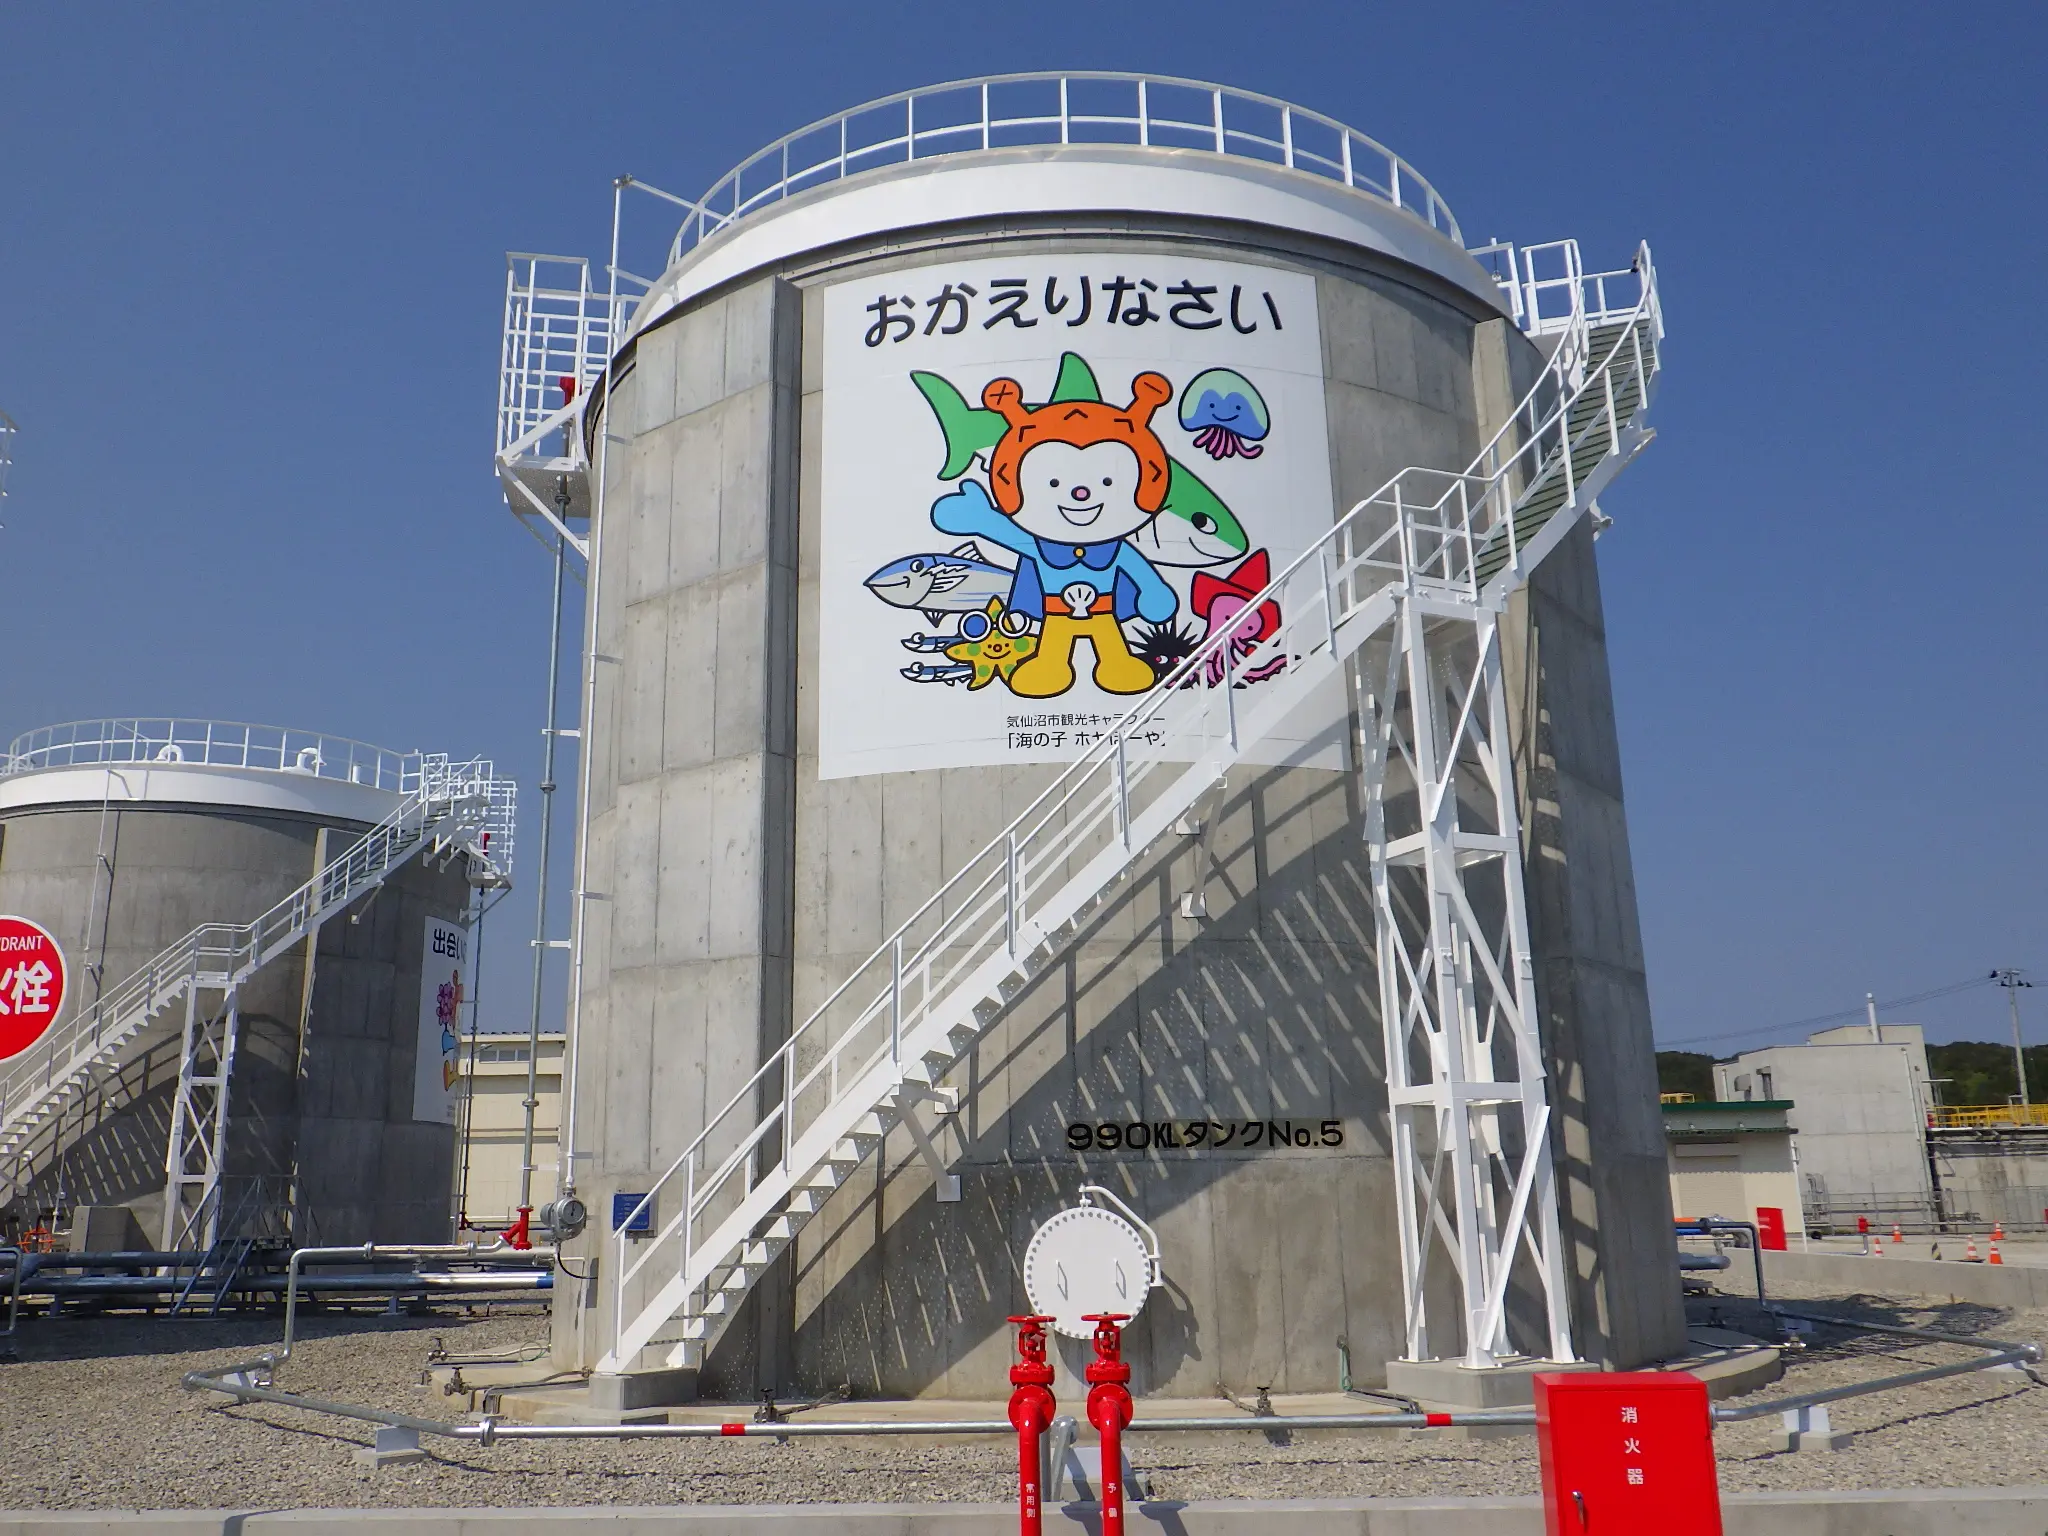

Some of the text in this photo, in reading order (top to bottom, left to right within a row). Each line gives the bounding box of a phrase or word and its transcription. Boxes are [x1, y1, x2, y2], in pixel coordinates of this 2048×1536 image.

[864, 275, 1283, 347] おかえりなさい
[0, 935, 44, 952] DRANT
[1621, 1406, 1644, 1486] 消火器
